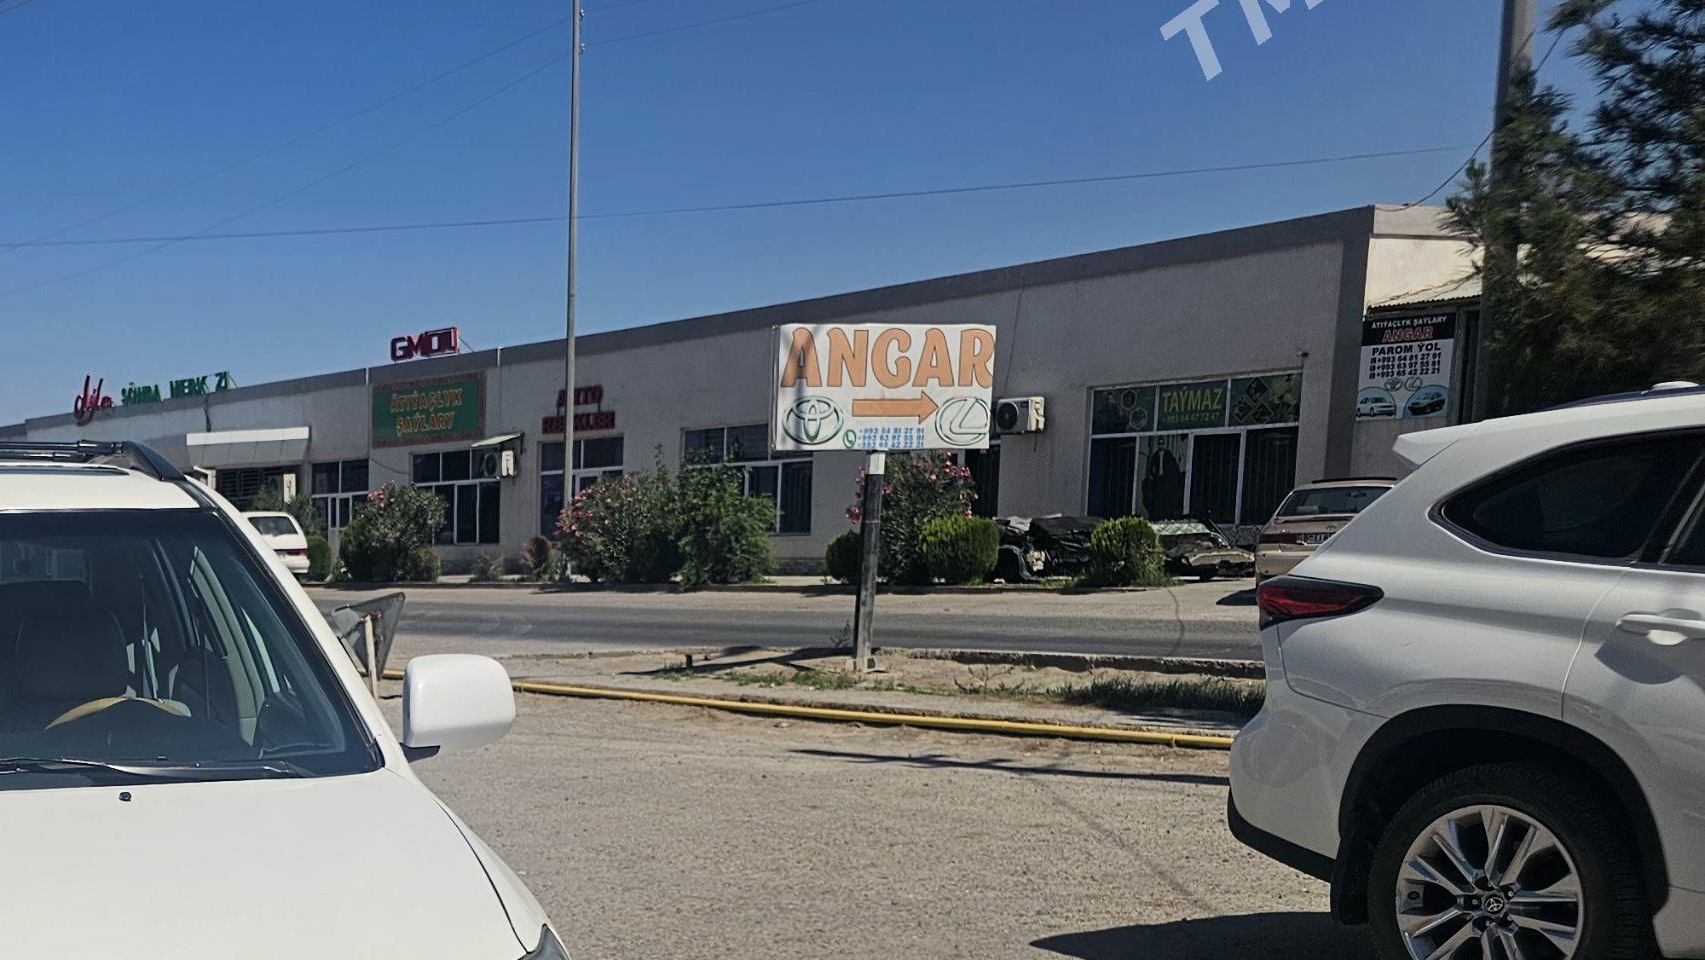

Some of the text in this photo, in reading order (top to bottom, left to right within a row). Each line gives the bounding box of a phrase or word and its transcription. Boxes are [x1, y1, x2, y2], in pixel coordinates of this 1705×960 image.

[1382, 326, 1433, 342] ANGAR
[781, 327, 994, 389] ANGAR
[1372, 345, 1413, 356] PAROM
